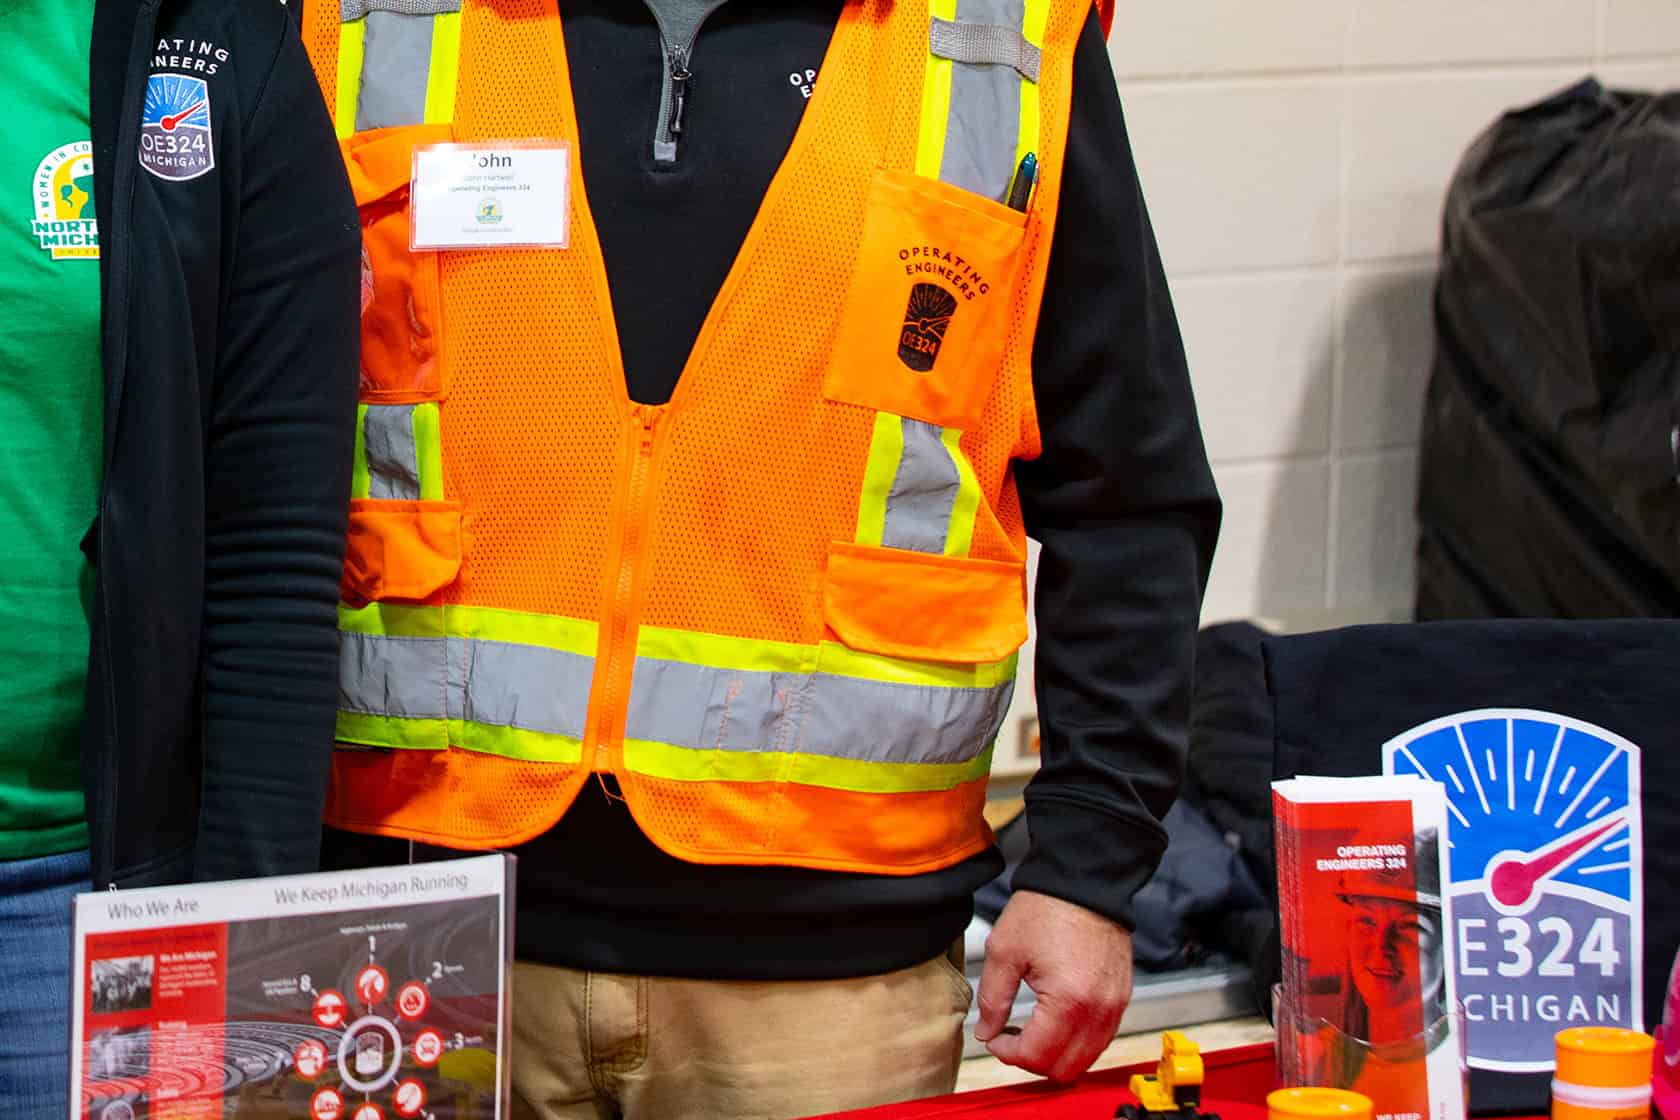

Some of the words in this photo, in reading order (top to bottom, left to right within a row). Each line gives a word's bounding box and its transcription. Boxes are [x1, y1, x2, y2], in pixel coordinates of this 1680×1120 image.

[141, 133, 206, 153] OE324
[143, 153, 206, 168] MICHIGAN
[39, 164, 52, 208] WOMEN
[898, 246, 990, 295] OPERATING
[905, 262, 976, 301] ENGINEERS
[1336, 844, 1407, 858] OPERATING
[1316, 858, 1384, 871] ENGINEERS
[1385, 857, 1407, 870] 324
[274, 887, 297, 905] We
[300, 886, 337, 905] Keep
[341, 877, 408, 901] Michigan
[411, 871, 469, 893] Running
[107, 902, 143, 921] Who
[146, 900, 171, 917] We
[173, 898, 199, 914] Are
[432, 962, 443, 979] 2
[300, 974, 312, 993] 8
[454, 1032, 464, 1049] 3
